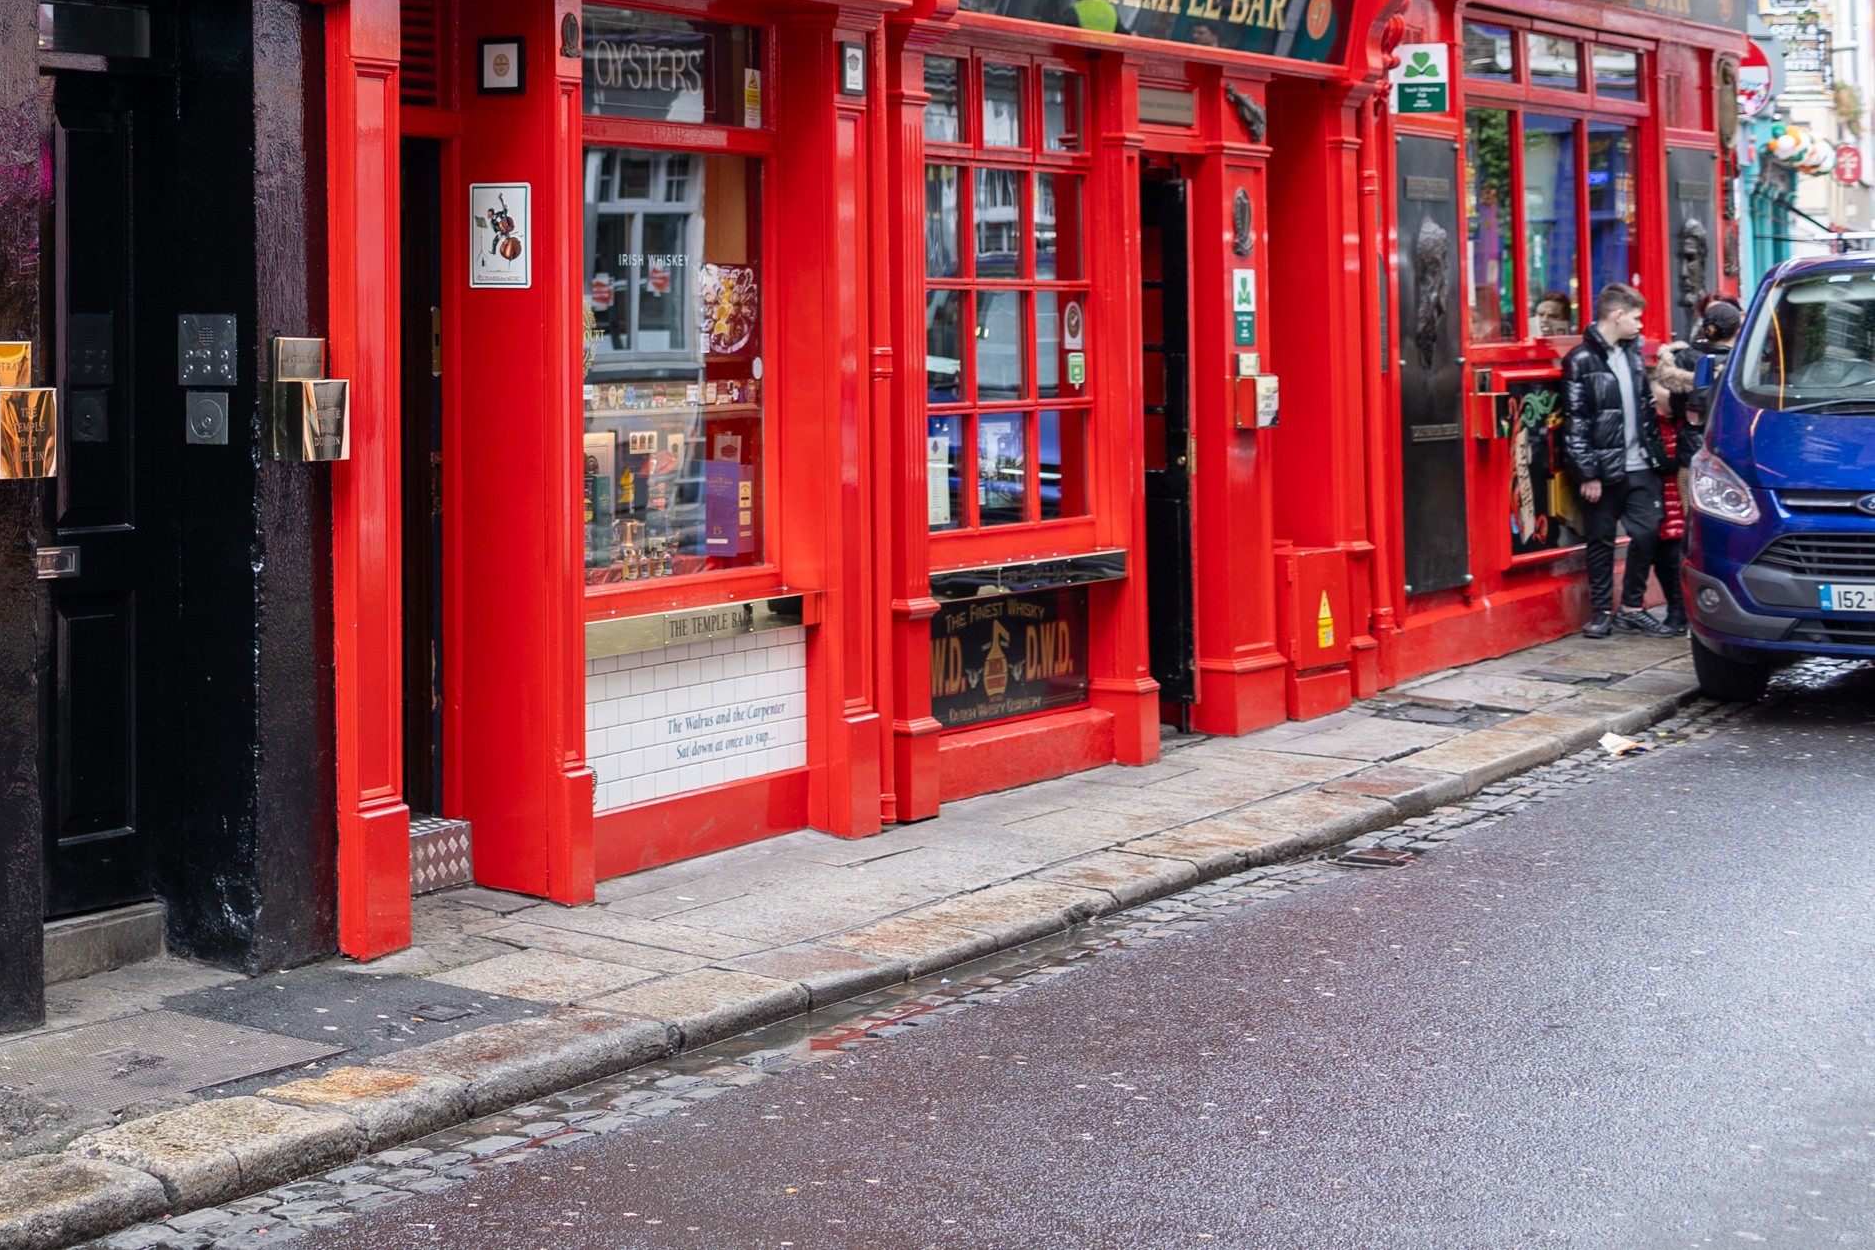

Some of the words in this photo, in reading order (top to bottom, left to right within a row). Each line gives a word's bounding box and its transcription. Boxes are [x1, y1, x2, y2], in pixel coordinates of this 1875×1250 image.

[1312, 0, 1328, 31] 47
[592, 38, 703, 97] OYSTERS
[618, 253, 644, 267] IRISH
[647, 254, 690, 267] WHISKEY
[669, 618, 688, 638] THE
[692, 613, 727, 633] TEMPLE
[731, 610, 753, 628] BAR
[946, 611, 966, 633] THE
[969, 602, 1004, 623] FINEST
[1007, 598, 1045, 619] WHISKY
[1026, 621, 1074, 682] D.W.D.
[667, 719, 683, 735] The
[685, 714, 714, 732] Walrus
[716, 708, 731, 725] and
[733, 707, 744, 722] the
[747, 702, 785, 721] Carpenter
[676, 745, 689, 760] Sat
[692, 740, 713, 757] down
[715, 739, 723, 752] at
[725, 735, 743, 749] once
[745, 733, 752, 746] to
